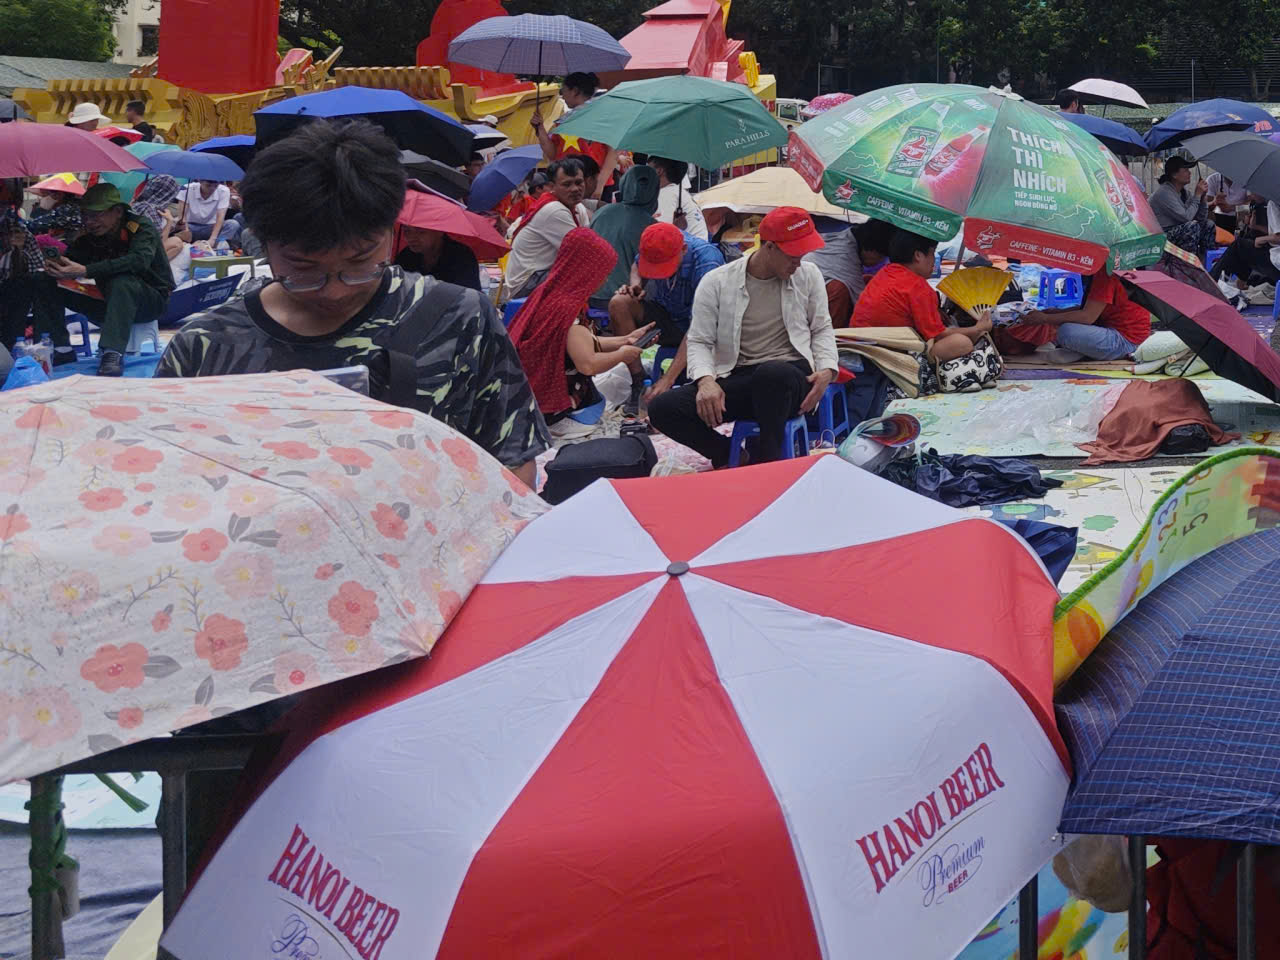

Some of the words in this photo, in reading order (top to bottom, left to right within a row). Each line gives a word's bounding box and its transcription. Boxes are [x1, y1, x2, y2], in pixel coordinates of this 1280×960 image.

[746, 129, 770, 142] HILLS
[1007, 126, 1064, 154] THÍCH
[1012, 146, 1044, 169] THÌ
[1013, 168, 1067, 193] NHÍCH
[867, 195, 896, 212] CAFFEINE
[898, 205, 922, 222] VITAMIN
[922, 215, 932, 224] B3
[1009, 240, 1039, 253] CAFFEINE
[1042, 247, 1067, 260] VITAMIN
[1067, 253, 1076, 261] B3
[856, 791, 946, 894] HANOI
[938, 742, 1006, 820] BEER
[917, 836, 986, 908] Premium
[947, 869, 969, 894] BEER
[267, 823, 351, 921] HANOI
[333, 885, 401, 960] BEER
